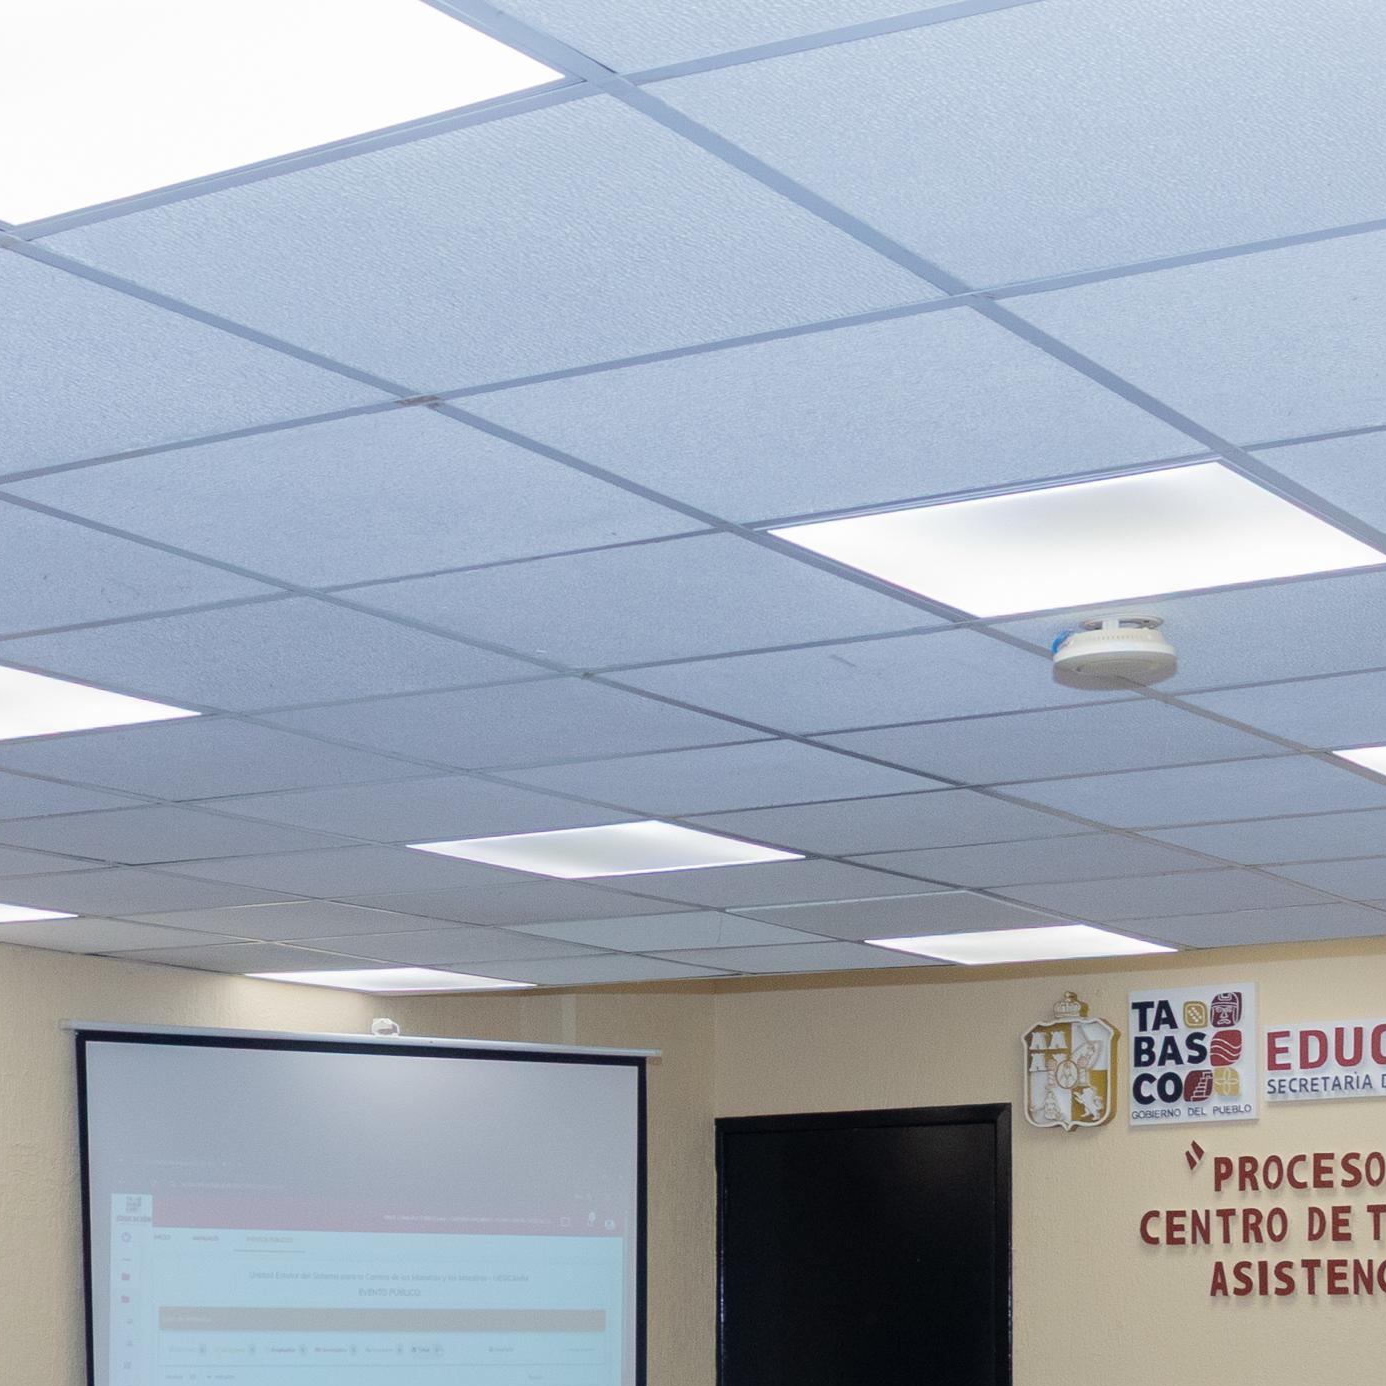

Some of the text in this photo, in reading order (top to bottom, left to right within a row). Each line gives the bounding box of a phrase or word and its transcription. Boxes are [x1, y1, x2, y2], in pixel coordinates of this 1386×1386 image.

[1131, 999, 1179, 1033] TA
[1133, 1031, 1208, 1068] BAS
[1132, 1071, 1184, 1105] CO
[1131, 1103, 1252, 1120] GOBIERNO DEL PUEBLO
[1139, 1207, 1289, 1246] CENTRO
[1307, 1205, 1353, 1243] DE
